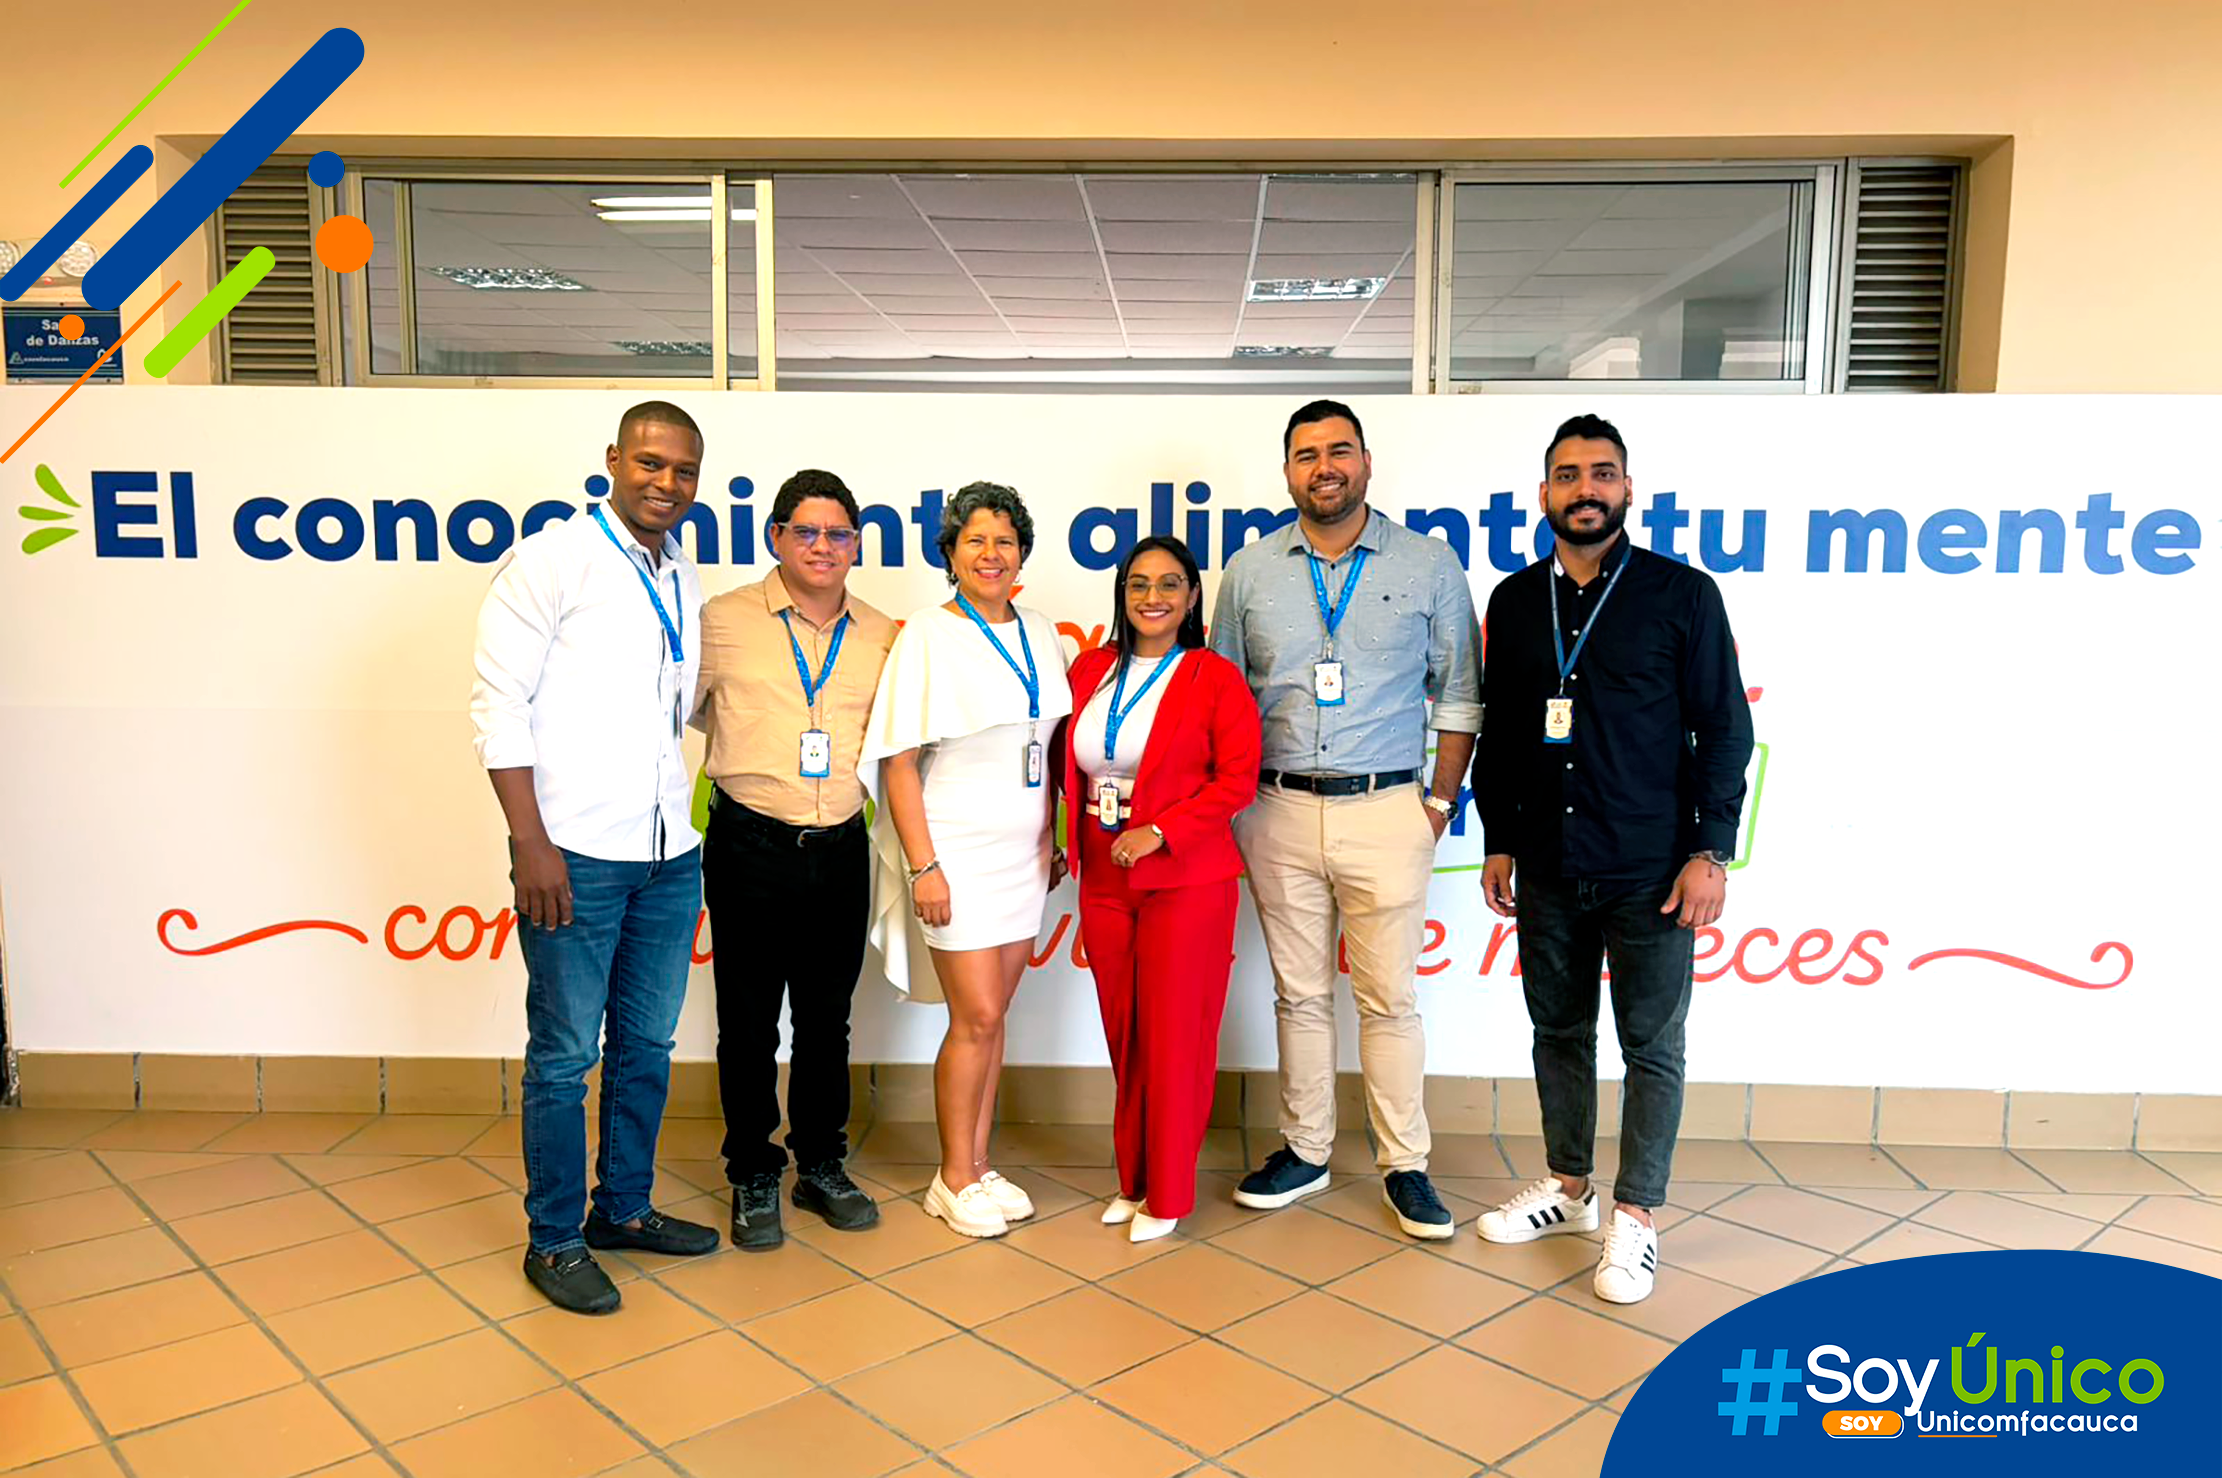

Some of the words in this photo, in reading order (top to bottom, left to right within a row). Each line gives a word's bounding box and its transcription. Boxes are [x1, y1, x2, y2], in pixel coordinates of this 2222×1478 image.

[26, 335, 44, 346] de
[92, 470, 198, 559] El
[1641, 491, 1767, 574] tu
[1805, 492, 2203, 576] mente
